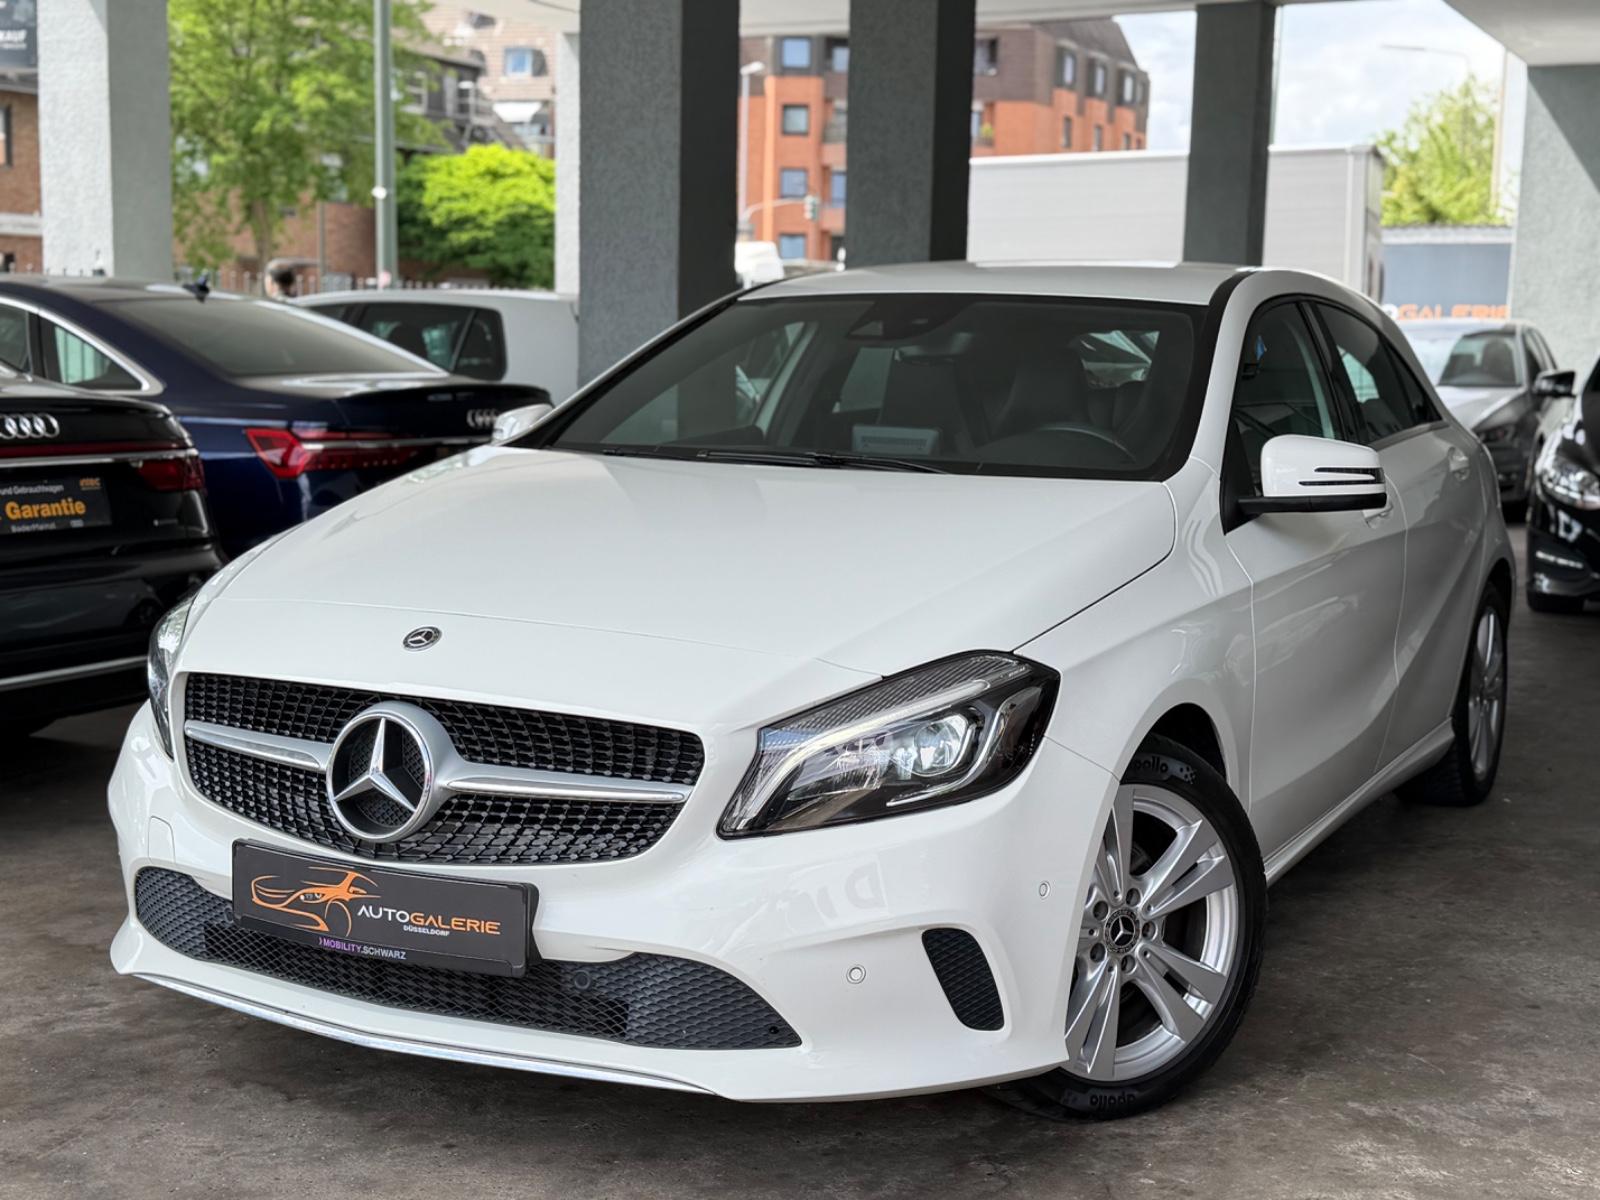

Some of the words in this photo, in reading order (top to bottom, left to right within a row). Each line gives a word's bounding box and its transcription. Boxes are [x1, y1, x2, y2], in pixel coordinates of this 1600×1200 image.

[5, 497, 86, 520] Garantie
[357, 904, 501, 935] AUTOGALERIE
[403, 924, 450, 937] DÜSSELDORF
